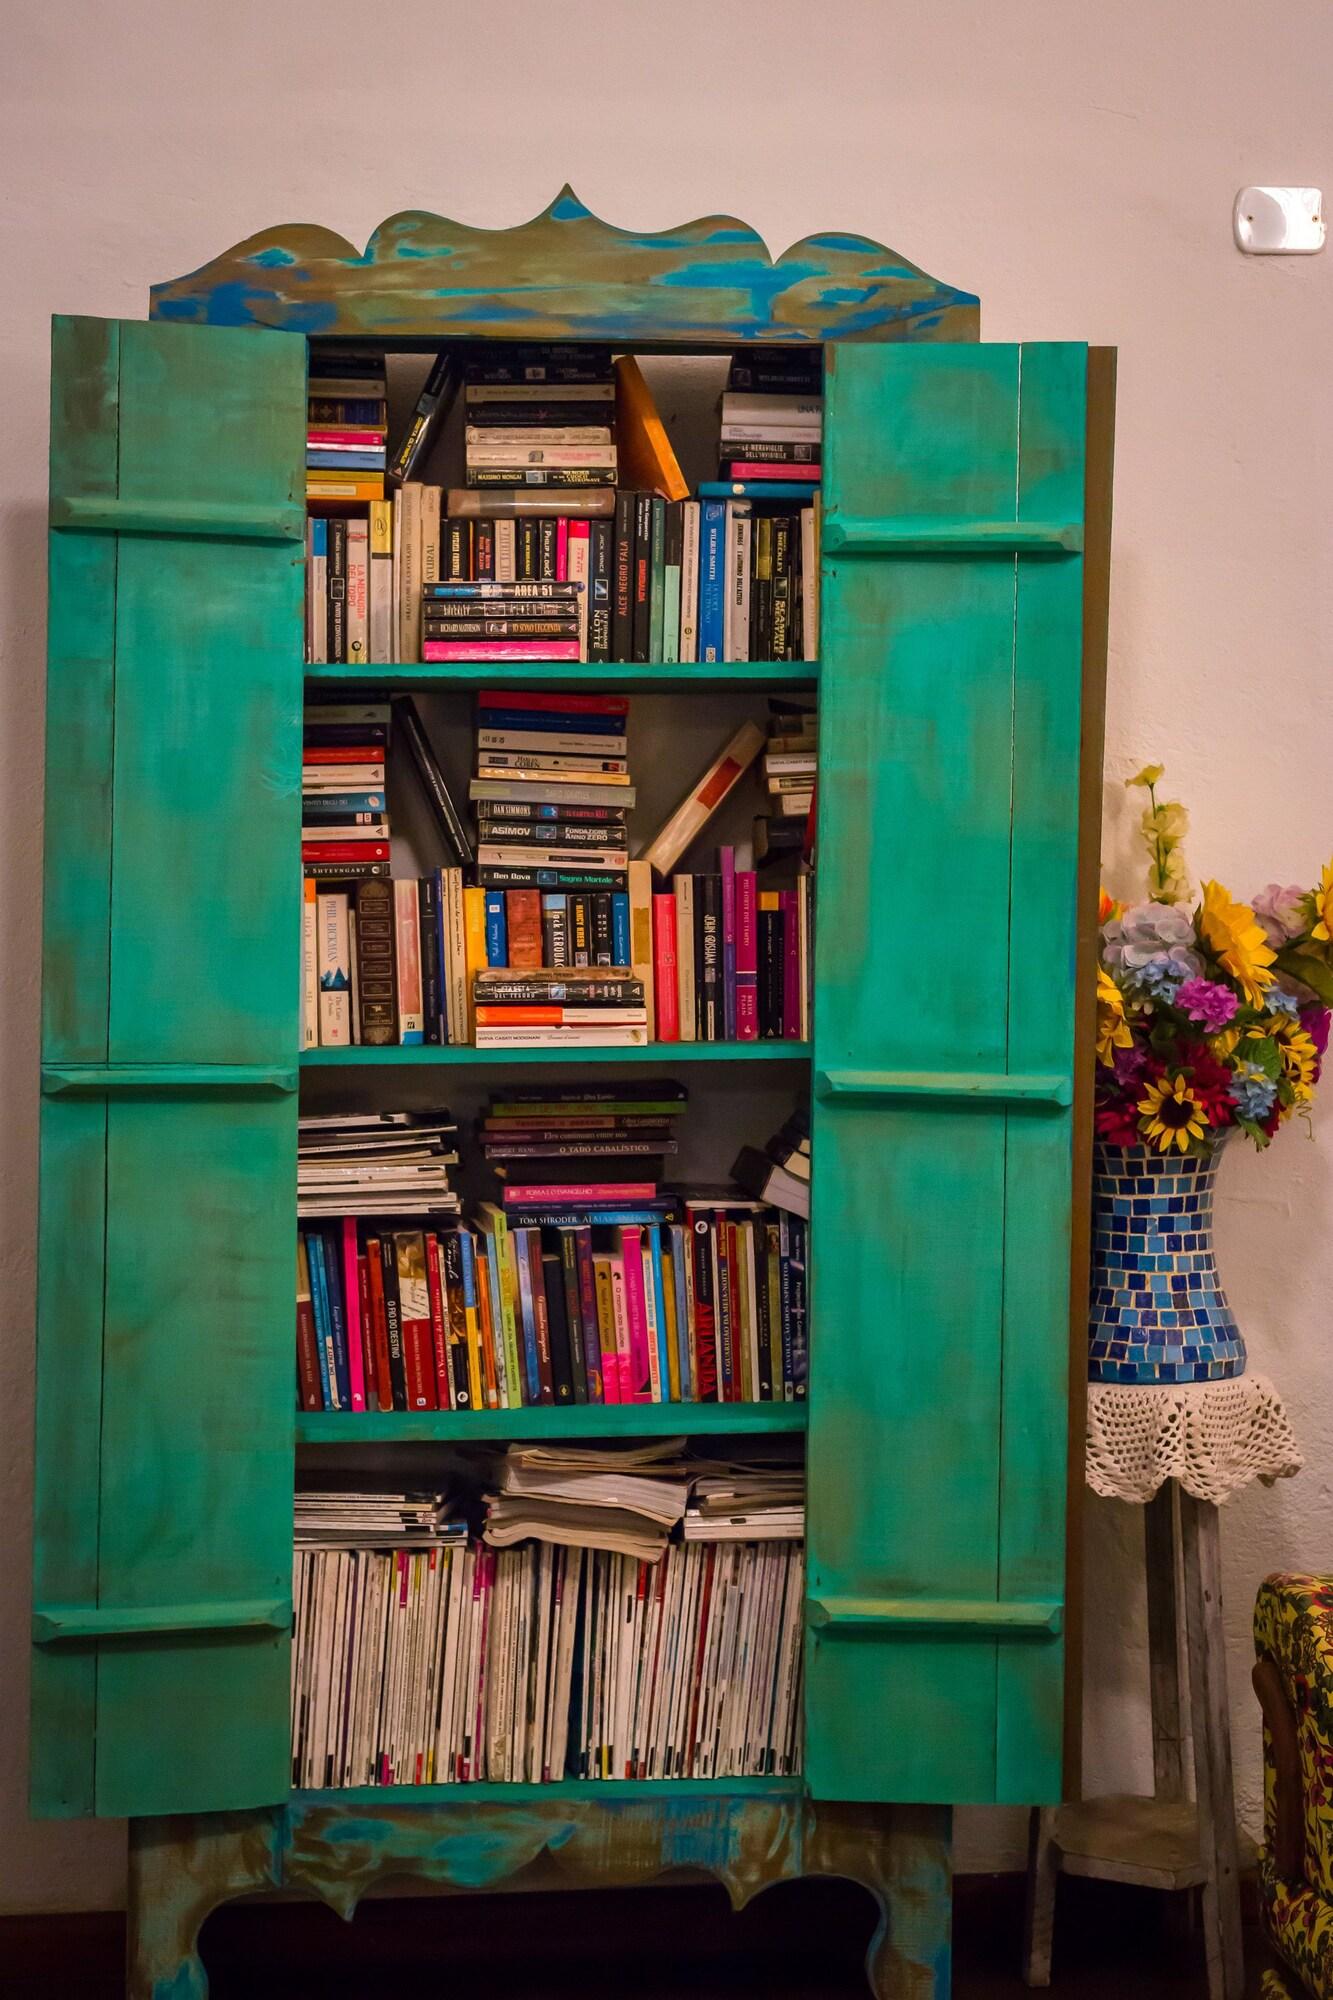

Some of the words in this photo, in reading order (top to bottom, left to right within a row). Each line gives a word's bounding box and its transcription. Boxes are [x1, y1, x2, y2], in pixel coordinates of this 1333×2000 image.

[750, 444, 784, 452] MERAVIGLIE
[544, 530, 552, 552] PHILIP
[618, 540, 628, 562] FALA
[776, 532, 784, 574] SHECKLEY
[348, 564, 356, 582] DEL
[356, 564, 365, 578] LA
[544, 560, 554, 577] DICK
[618, 564, 628, 592] NEGRO
[348, 584, 356, 608] TOPO
[356, 578, 366, 620] MEMORIA
[514, 585, 538, 596] AREA
[542, 584, 552, 596] 51
[618, 596, 628, 616] ALCE
[534, 623, 562, 632] LEGGENDA
[493, 804, 505, 814] DAN
[506, 804, 531, 816] SIMMONS
[492, 826, 531, 836] ASIMOV
[565, 827, 608, 835] FONDAZIONE
[493, 872, 509, 880] Ben
[511, 872, 531, 880] Bova
[326, 900, 338, 920] PHIL
[576, 904, 584, 926] NANCY
[552, 911, 564, 928] Jack
[704, 914, 716, 933] JOHN
[327, 923, 338, 962] RICKMAN
[576, 927, 585, 948] KRESS
[704, 935, 716, 964] GRISHAM
[540, 1216, 578, 1224] SHRODER
[389, 1320, 396, 1329] DO
[722, 1313, 729, 1324] DA
[437, 1325, 442, 1333] de
[390, 1330, 400, 1358] DESTINO
[694, 1302, 716, 1395] ARUANDA
[723, 1326, 731, 1367] GUARDIÃO
[786, 1366, 792, 1374] A
